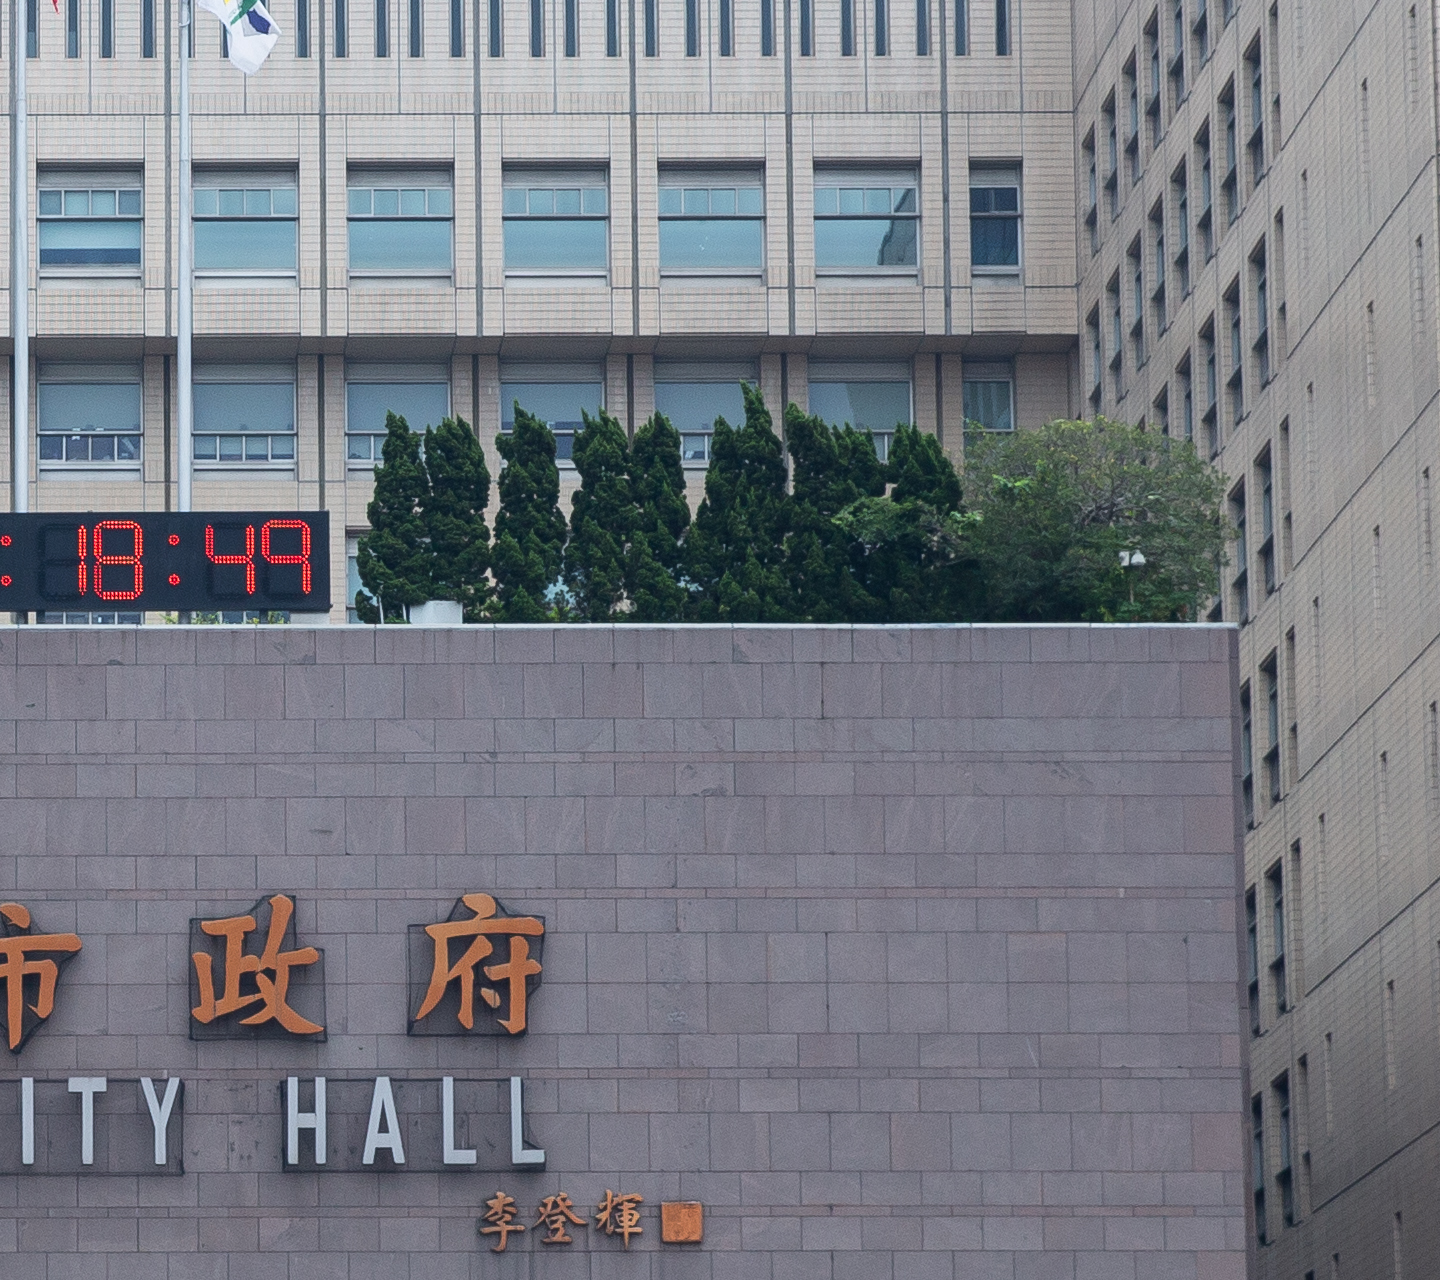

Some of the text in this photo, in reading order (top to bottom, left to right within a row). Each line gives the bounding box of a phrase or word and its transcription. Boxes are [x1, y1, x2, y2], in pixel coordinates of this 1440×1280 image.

[286, 1075, 547, 1166] HALL
[480, 1189, 645, 1252] 李登輝
